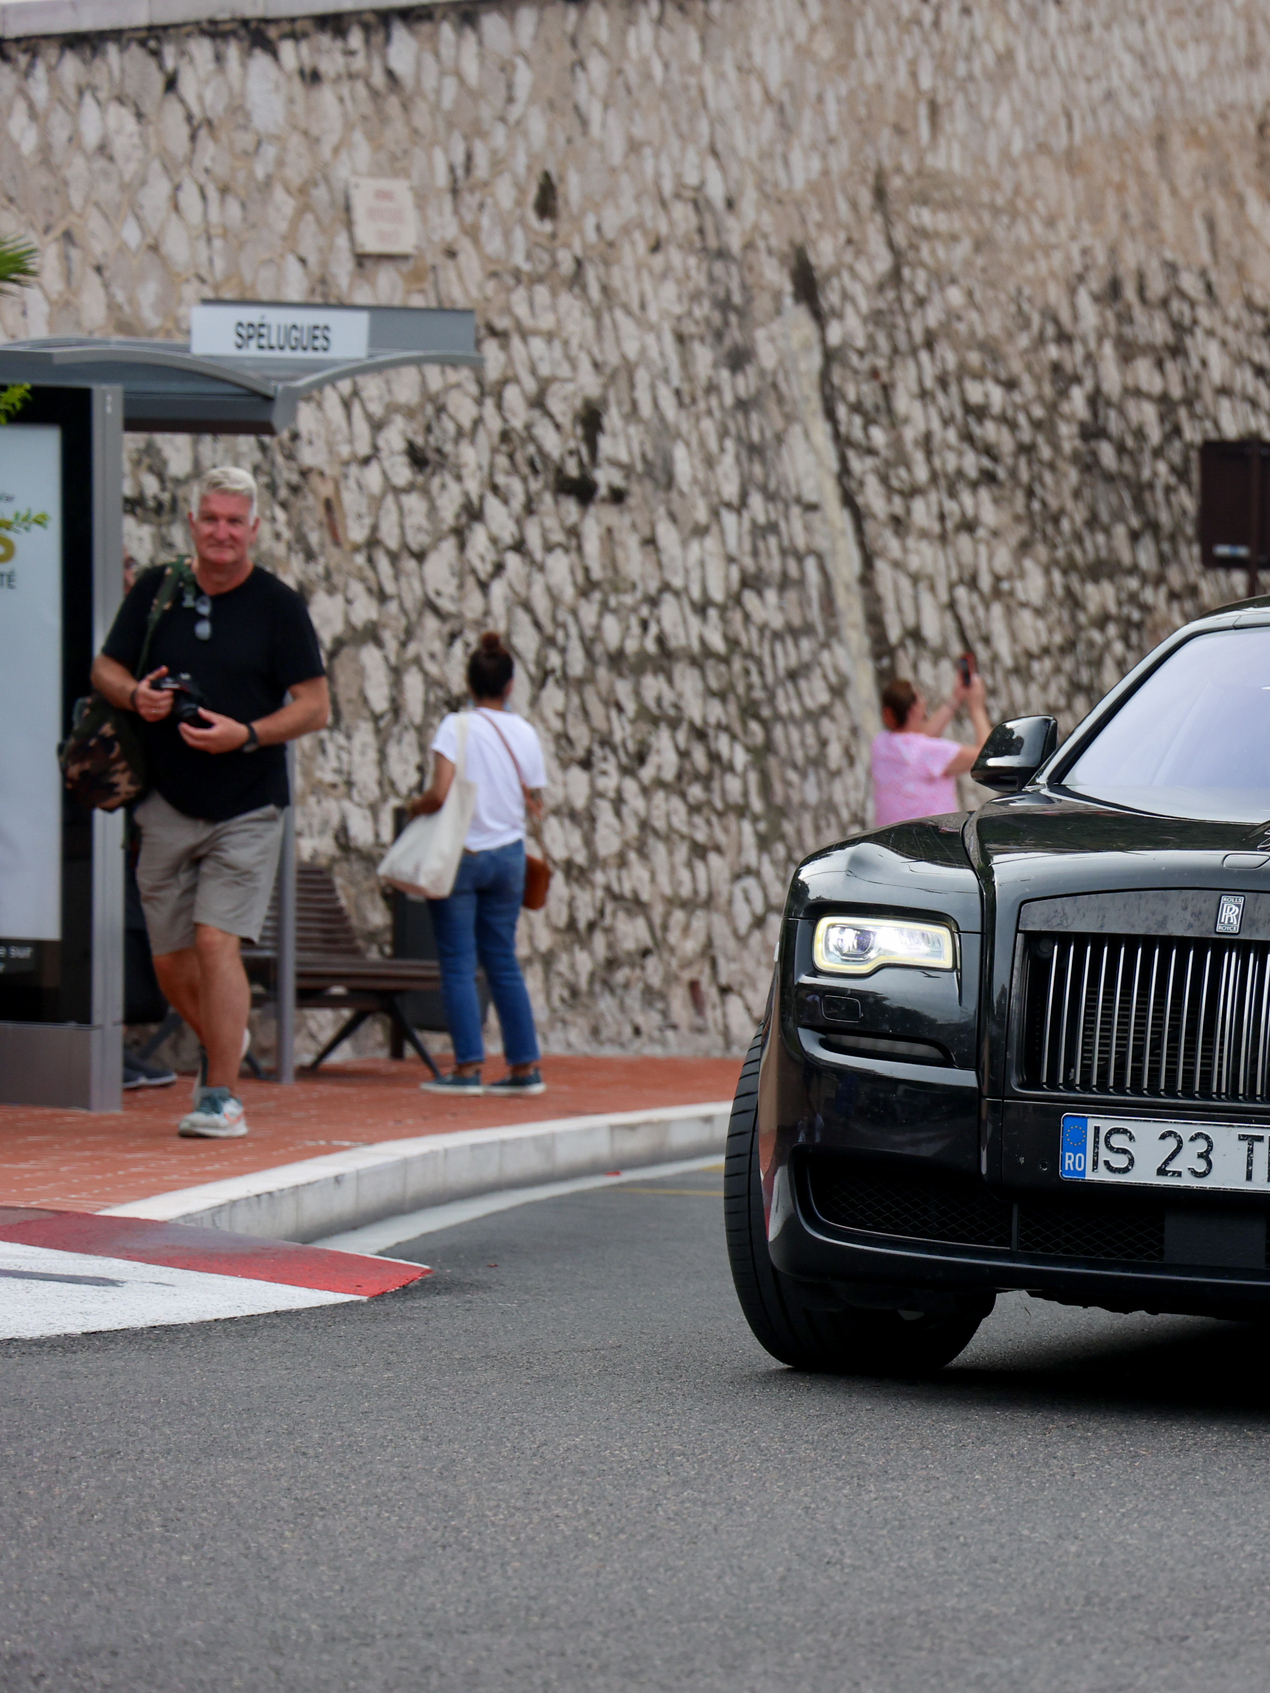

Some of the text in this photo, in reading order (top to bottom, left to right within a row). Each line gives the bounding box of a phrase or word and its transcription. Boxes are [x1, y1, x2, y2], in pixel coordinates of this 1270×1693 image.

[234, 315, 331, 351] SPÉLUGUES
[1065, 1152, 1085, 1172] RO
[1092, 1125, 1137, 1175] IS
[1156, 1129, 1215, 1179] 23
